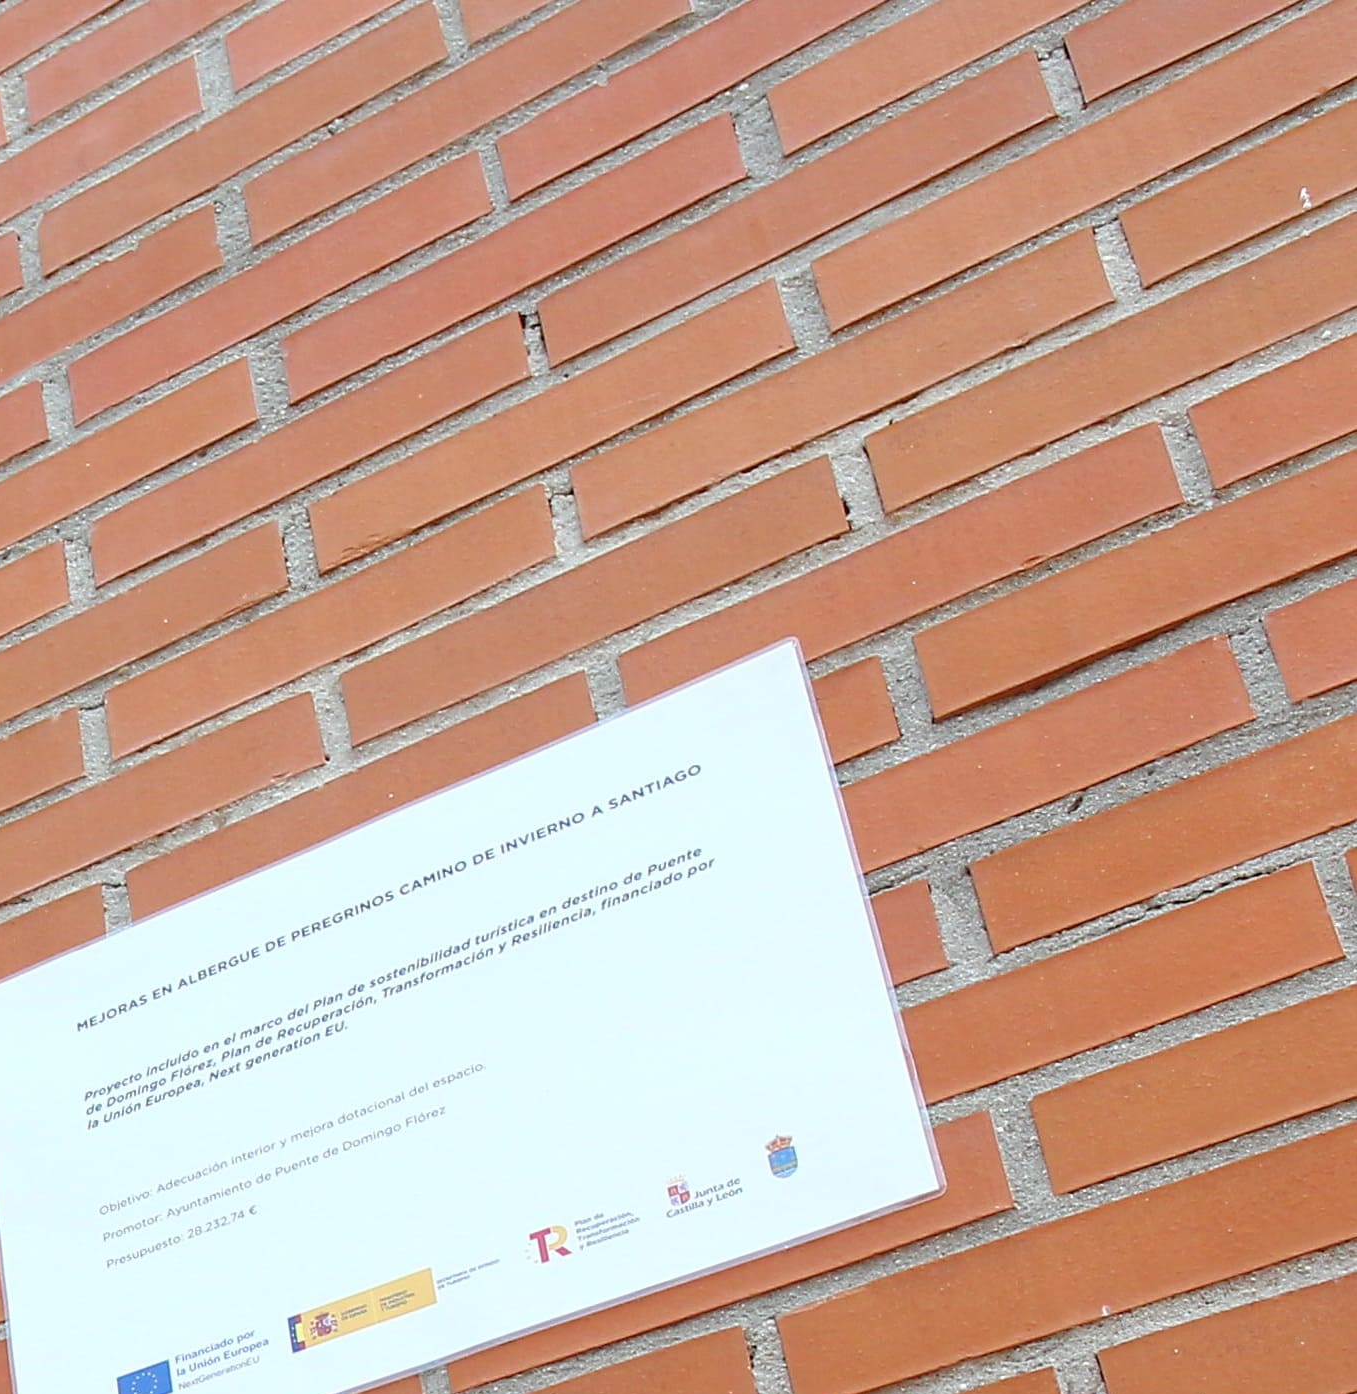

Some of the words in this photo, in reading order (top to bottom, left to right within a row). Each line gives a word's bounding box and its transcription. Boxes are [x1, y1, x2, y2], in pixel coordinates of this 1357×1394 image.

[76, 994, 148, 1032] MEJORAS
[152, 983, 172, 1000] EN
[177, 946, 260, 989] ALBERGUE
[265, 935, 286, 952] DE
[290, 890, 394, 942] PEREGRINOS
[399, 860, 467, 895] CAMINO
[472, 847, 495, 865] DE
[500, 812, 585, 854] INVIERNO
[591, 805, 604, 817] A
[608, 764, 701, 809] SANTIAGO
[84, 1072, 142, 1102] Proyecto
[146, 1049, 199, 1077] incluido
[202, 1041, 220, 1053] en
[223, 1032, 236, 1046] el
[239, 1016, 283, 1040] marco
[286, 1003, 309, 1021] del
[312, 992, 343, 1011] Plan
[347, 983, 365, 997] de
[369, 937, 470, 988] sostenibilidad
[474, 914, 534, 945] turística
[539, 905, 557, 919] en
[561, 881, 618, 910] destino
[622, 871, 642, 885] de
[647, 848, 702, 876] Puente
[85, 1103, 102, 1116] de
[106, 1077, 166, 1108] Domingo
[170, 1058, 216, 1082] Flórez,
[221, 1044, 251, 1062] Plan
[254, 1035, 272, 1049] de
[276, 995, 377, 1040] Recuperación,
[382, 947, 494, 998] Transformación
[498, 941, 507, 954] y
[511, 907, 596, 946] Resiliencia,
[601, 871, 683, 910] financiado
[687, 858, 715, 879] por
[87, 1119, 99, 1130] la
[103, 1102, 141, 1123] Unión
[145, 1079, 204, 1107] Europea,
[208, 1061, 241, 1082] Next
[245, 1032, 320, 1070] generation
[156, 1160, 228, 1193] Adecuación
[230, 1142, 276, 1165] interior
[279, 1138, 286, 1149] y
[290, 1120, 334, 1143] mejora
[337, 1090, 405, 1125] dotacional
[408, 1081, 429, 1097] del
[166, 1180, 252, 1218] Ayuntamiento
[255, 1172, 272, 1184] de
[274, 1154, 319, 1177] Puente
[322, 1147, 339, 1159] de
[342, 1123, 402, 1152] Domingo
[405, 1106, 446, 1128] Flórez
[694, 1183, 724, 1199] Junta
[726, 1177, 740, 1188] de
[666, 1200, 704, 1218] Castilla
[706, 1197, 713, 1207] y
[715, 1182, 743, 1202] León
[174, 1337, 234, 1364] Financiado
[236, 1329, 254, 1344] por
[176, 1368, 186, 1377] la
[188, 1355, 221, 1372] Unión
[223, 1338, 269, 1360] Europea
